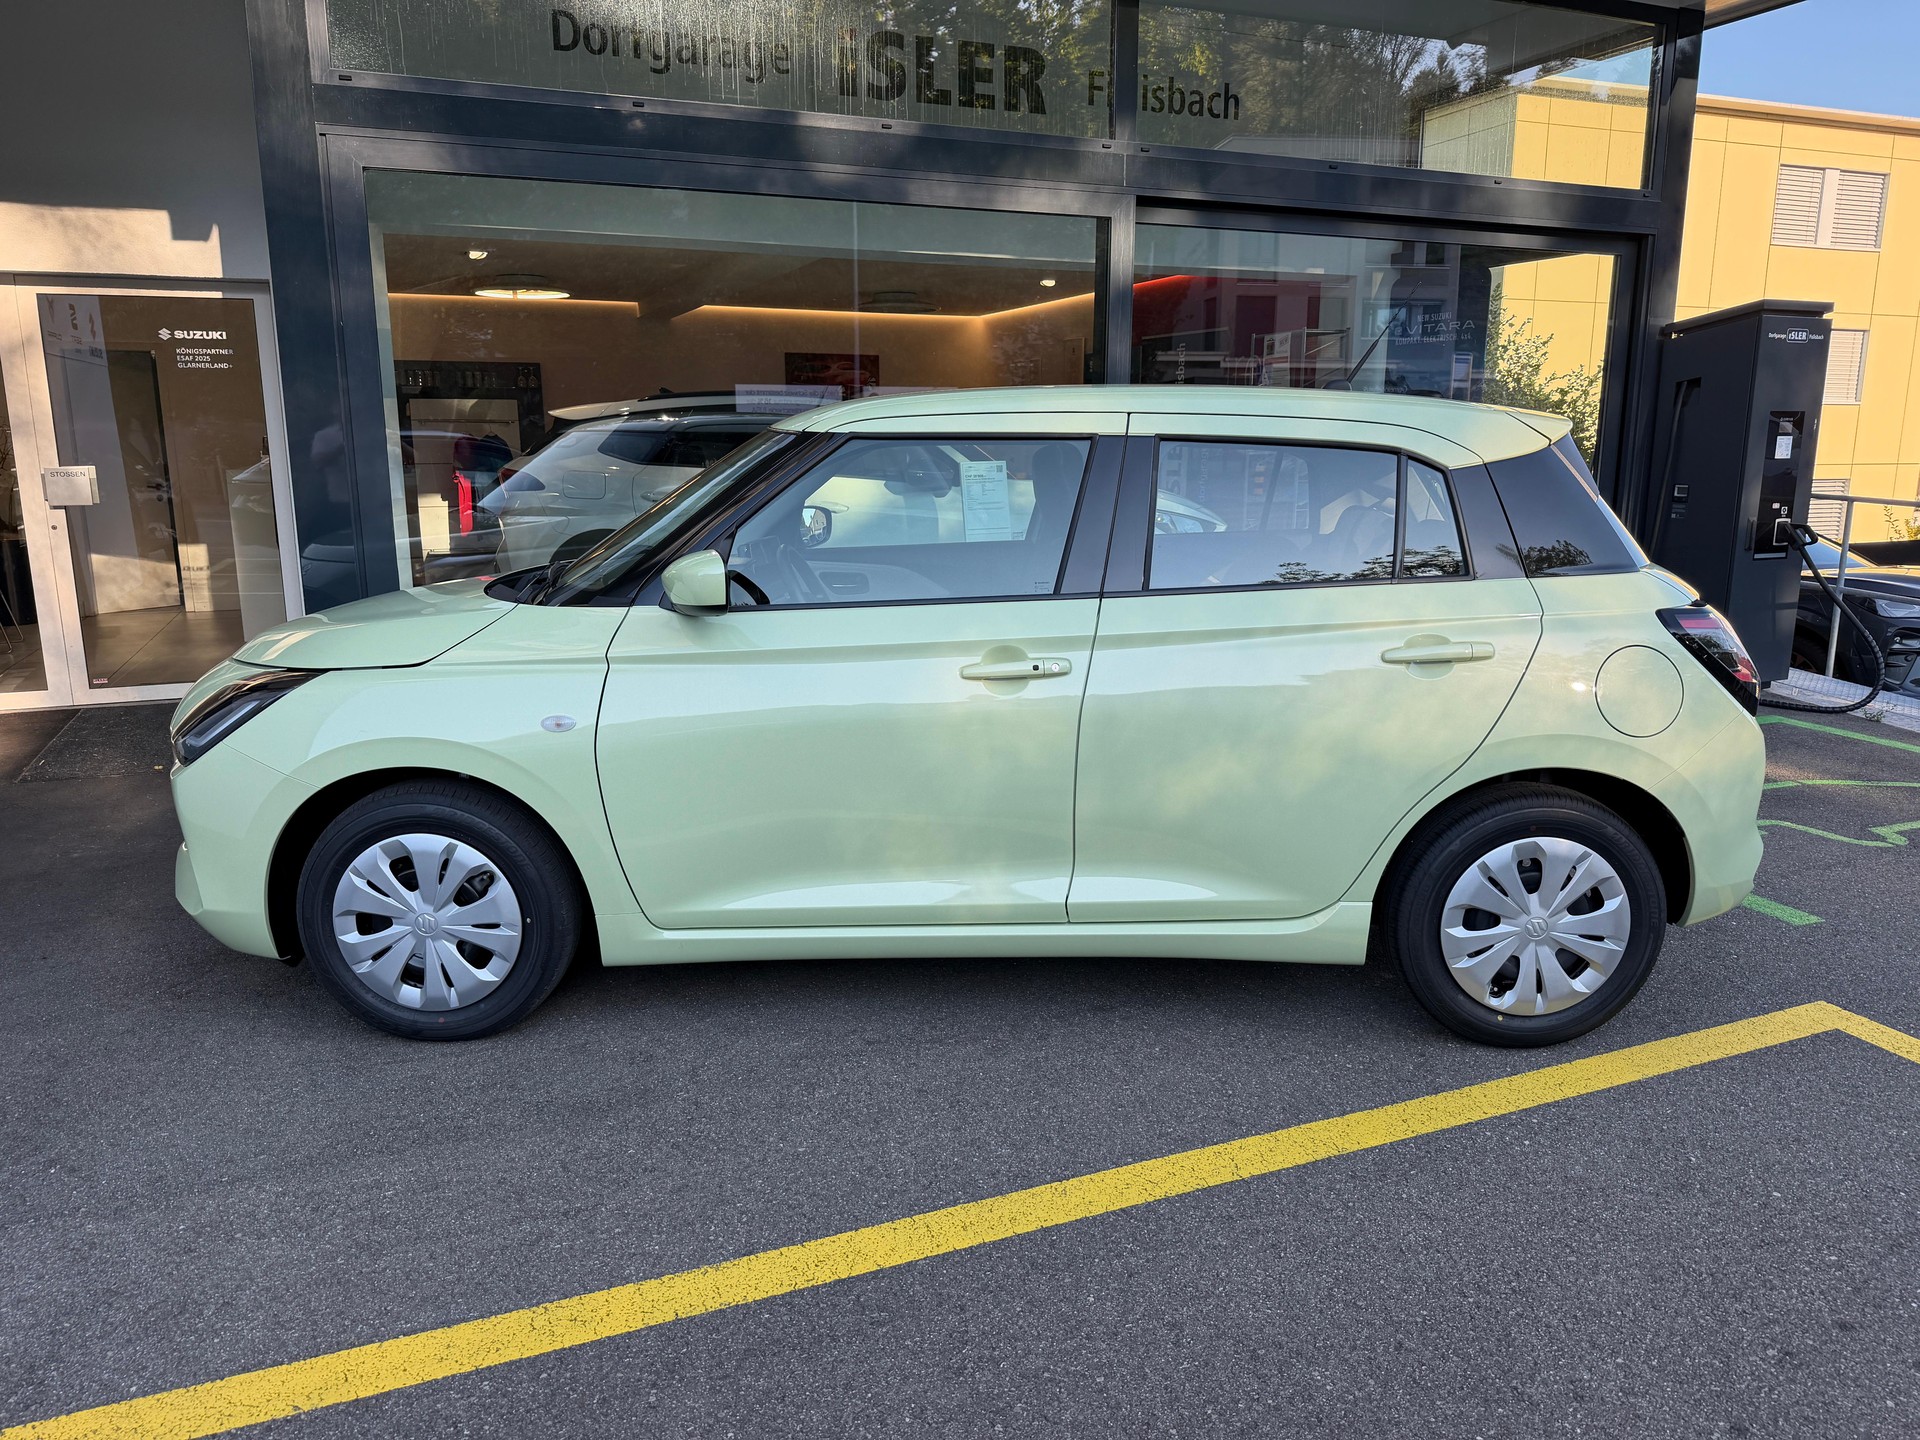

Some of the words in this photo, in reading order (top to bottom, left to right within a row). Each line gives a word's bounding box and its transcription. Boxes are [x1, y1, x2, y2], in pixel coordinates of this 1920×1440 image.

[1417, 313, 1430, 322] NEW
[1431, 311, 1452, 321] SUZUKI
[173, 330, 227, 340] SUZUKI
[175, 346, 234, 355] KÖNIGSPARTNER
